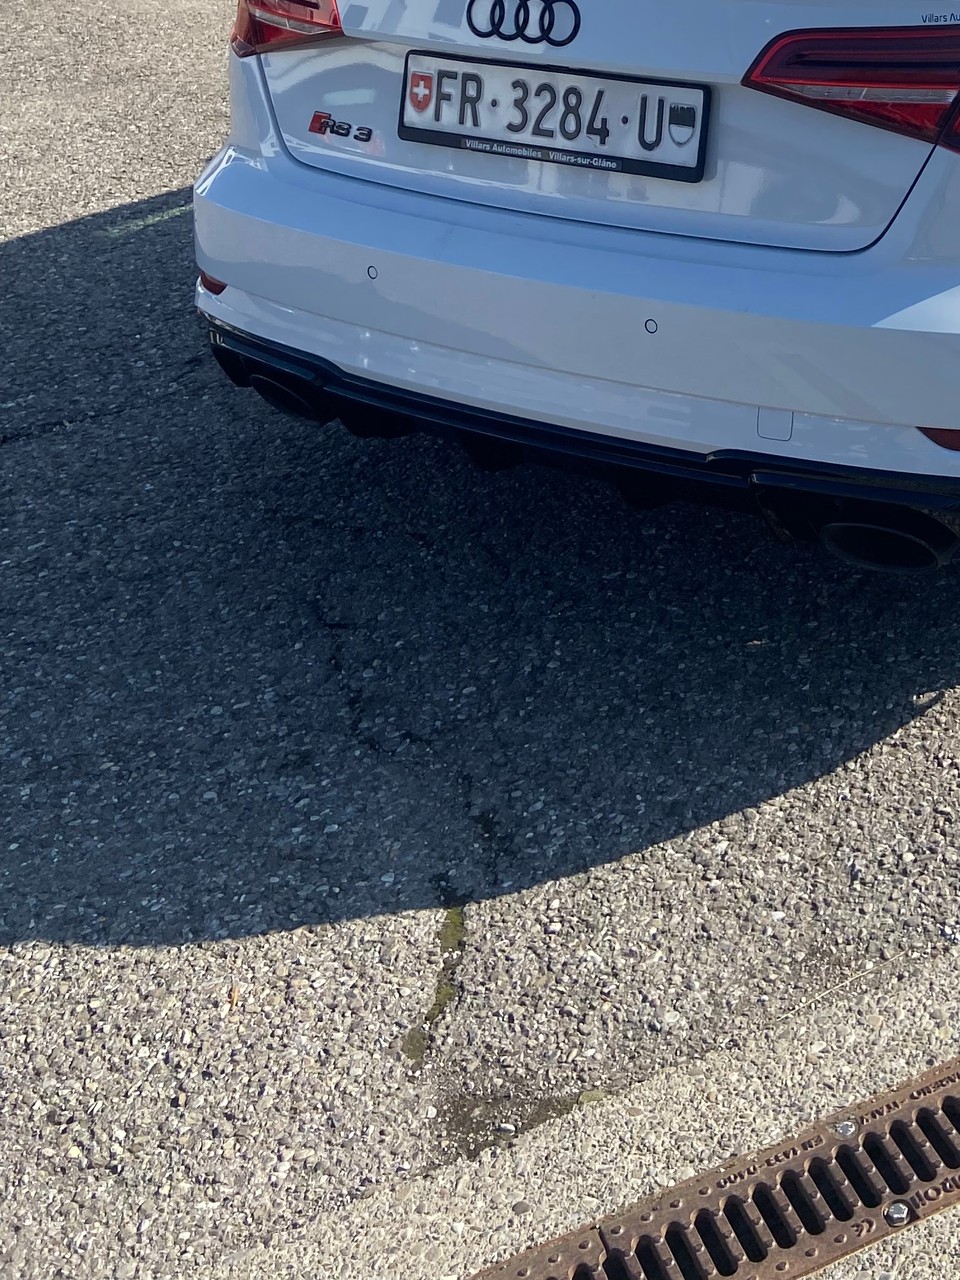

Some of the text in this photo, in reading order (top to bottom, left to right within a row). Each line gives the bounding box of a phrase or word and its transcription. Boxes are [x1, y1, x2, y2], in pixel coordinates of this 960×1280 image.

[921, 14, 948, 23] Villars
[505, 79, 610, 146] 3284
[465, 138, 491, 152] Villars
[492, 142, 542, 158] Automobiles
